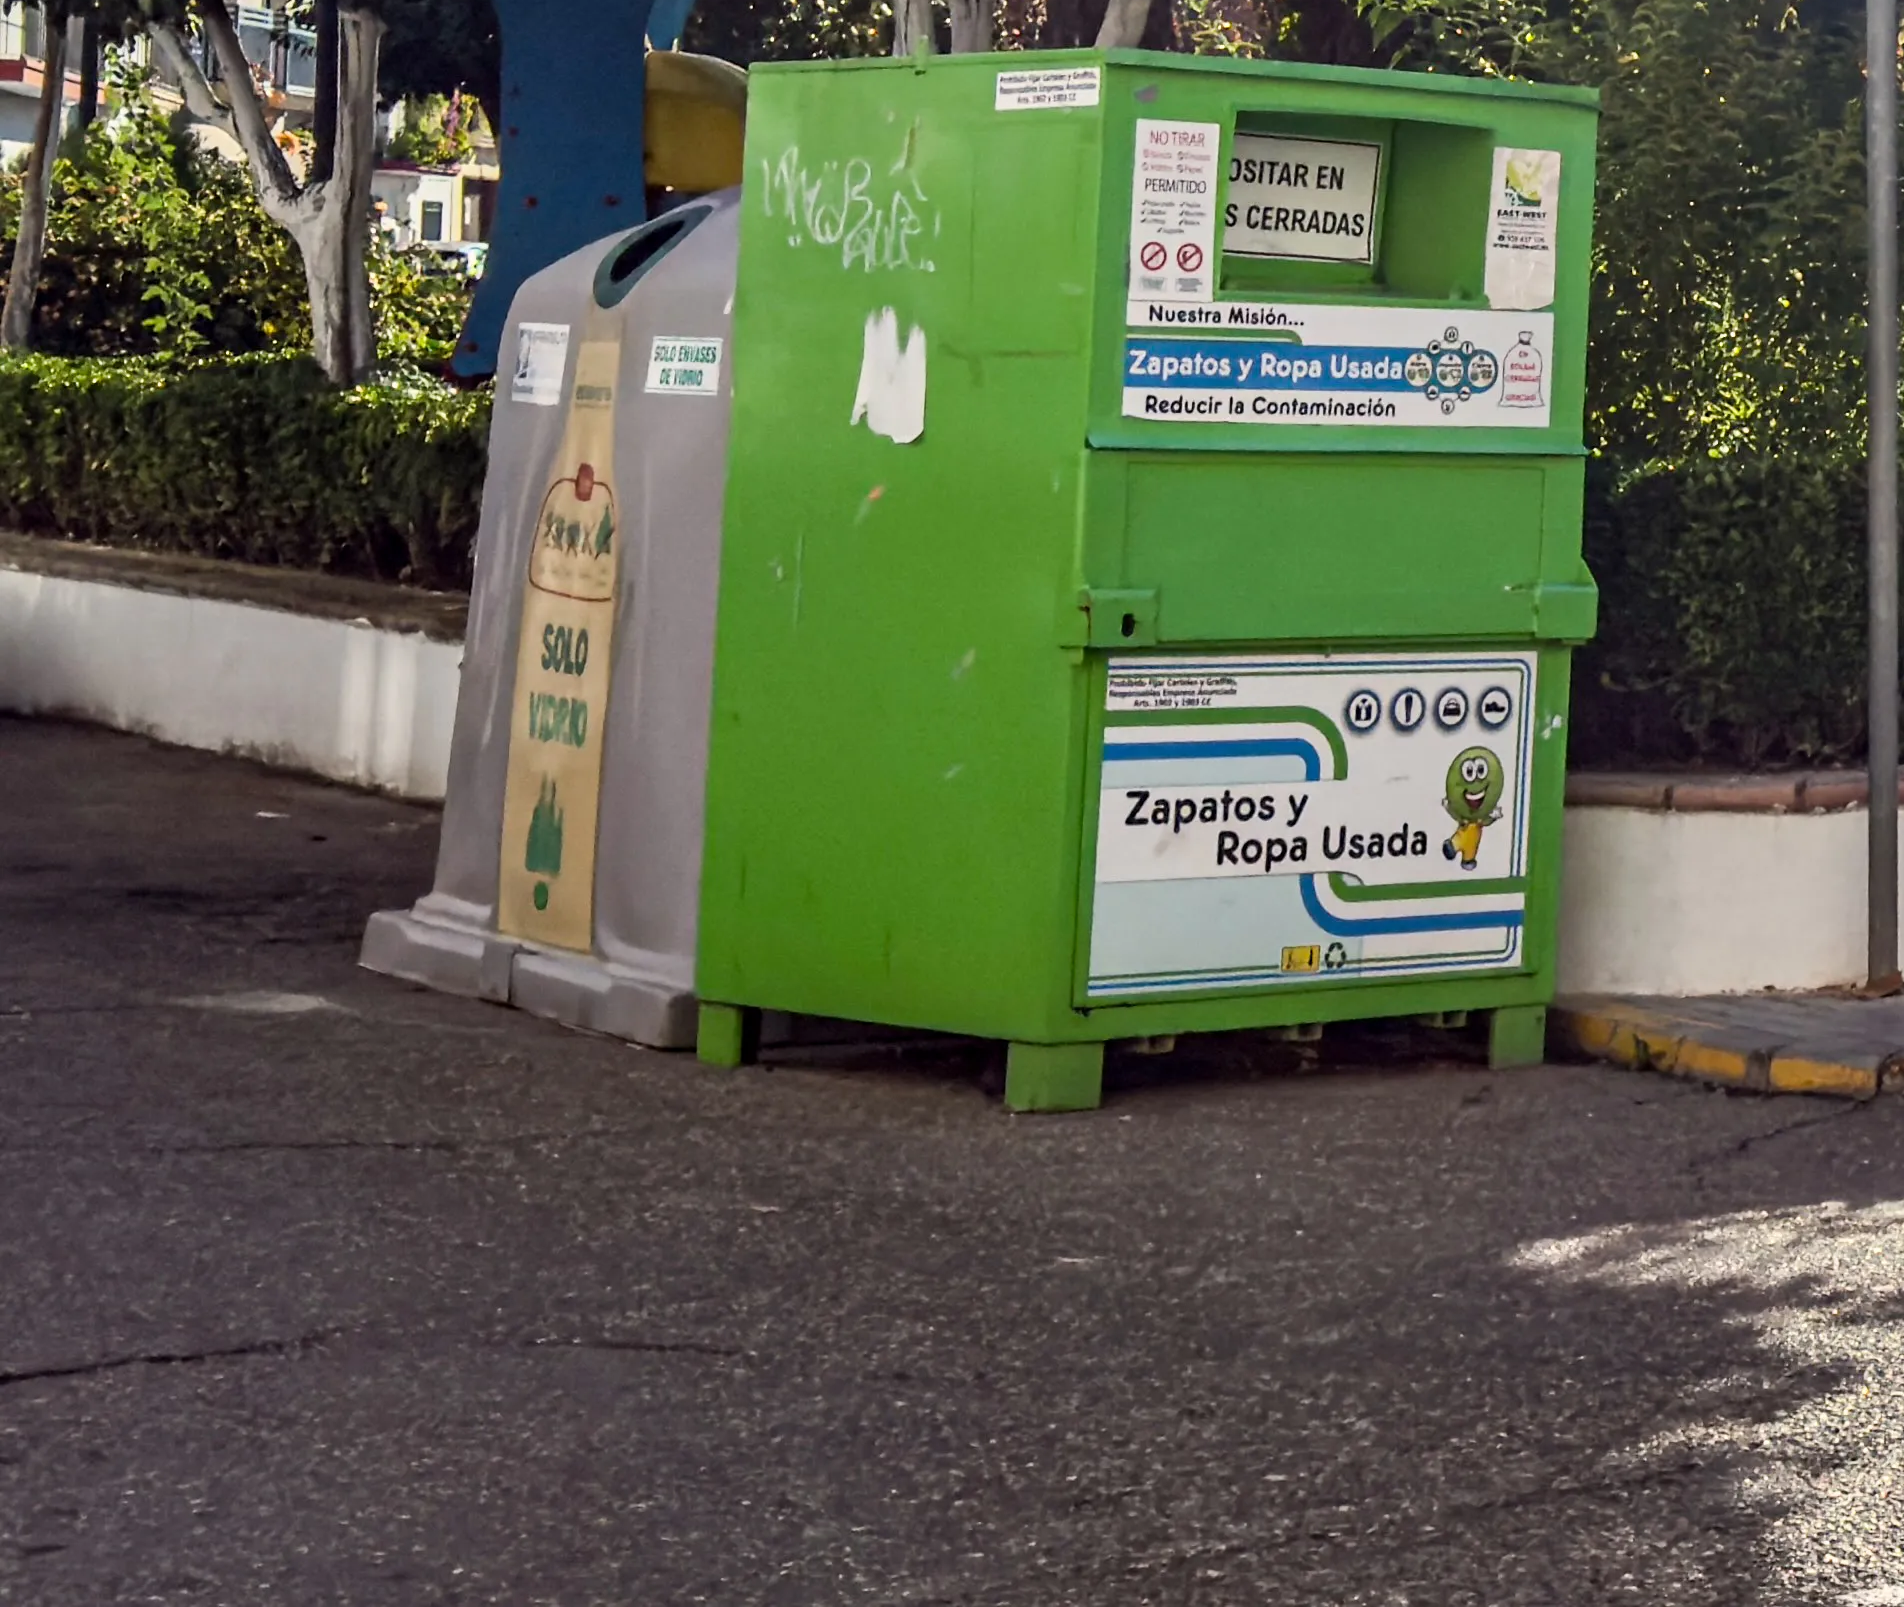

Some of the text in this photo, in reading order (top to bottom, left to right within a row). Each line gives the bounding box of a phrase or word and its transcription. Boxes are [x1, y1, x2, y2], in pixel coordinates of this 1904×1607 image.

[1150, 130, 1205, 147] NO TIRAR
[1144, 178, 1207, 194] PERMITIDO
[1316, 165, 1344, 191] EN
[1246, 205, 1365, 237] CERRADAS
[1149, 305, 1304, 327] Nuestra Misión...
[654, 344, 717, 364] SOLO ENVASES
[1129, 350, 1402, 383] Zapatos y Ropa Usada
[659, 368, 703, 386] DE VIDRIO
[1145, 395, 1396, 417] Reducir la Contaminación
[541, 623, 588, 677] SOLO
[529, 692, 588, 748] VIDRIO
[1125, 790, 1309, 834] Zapatos y
[1217, 822, 1428, 873] Ropa Usada
